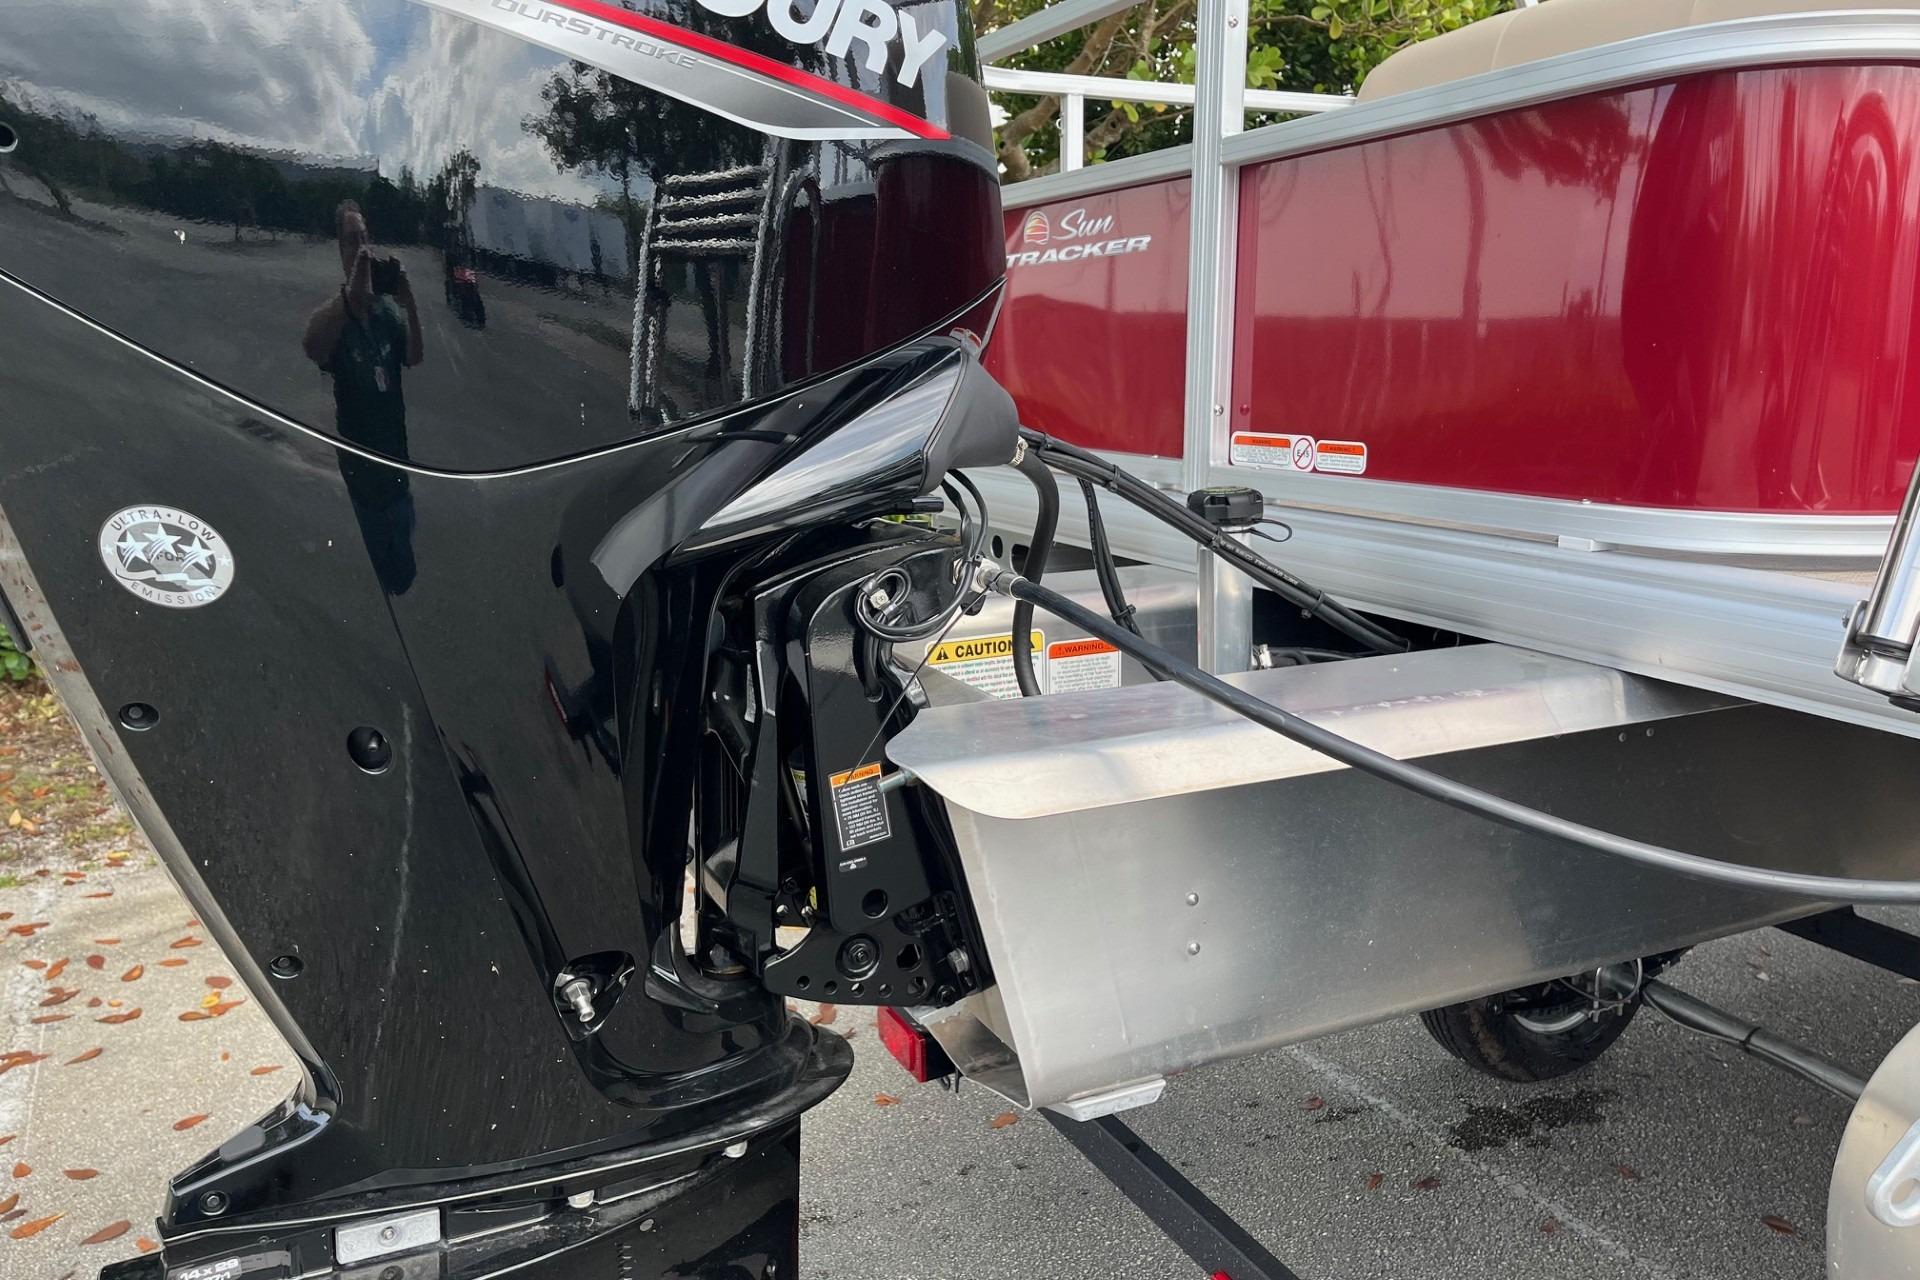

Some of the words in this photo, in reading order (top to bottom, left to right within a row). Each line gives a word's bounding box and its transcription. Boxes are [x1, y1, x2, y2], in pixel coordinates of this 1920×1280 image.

[694, 0, 947, 89] URY
[1052, 208, 1115, 241] Sun
[1006, 234, 1152, 269] TRACKER
[109, 508, 163, 532] ULTRA
[177, 514, 217, 542] LOW
[130, 581, 216, 606] EMISSION
[1064, 642, 1104, 653] WARNING
